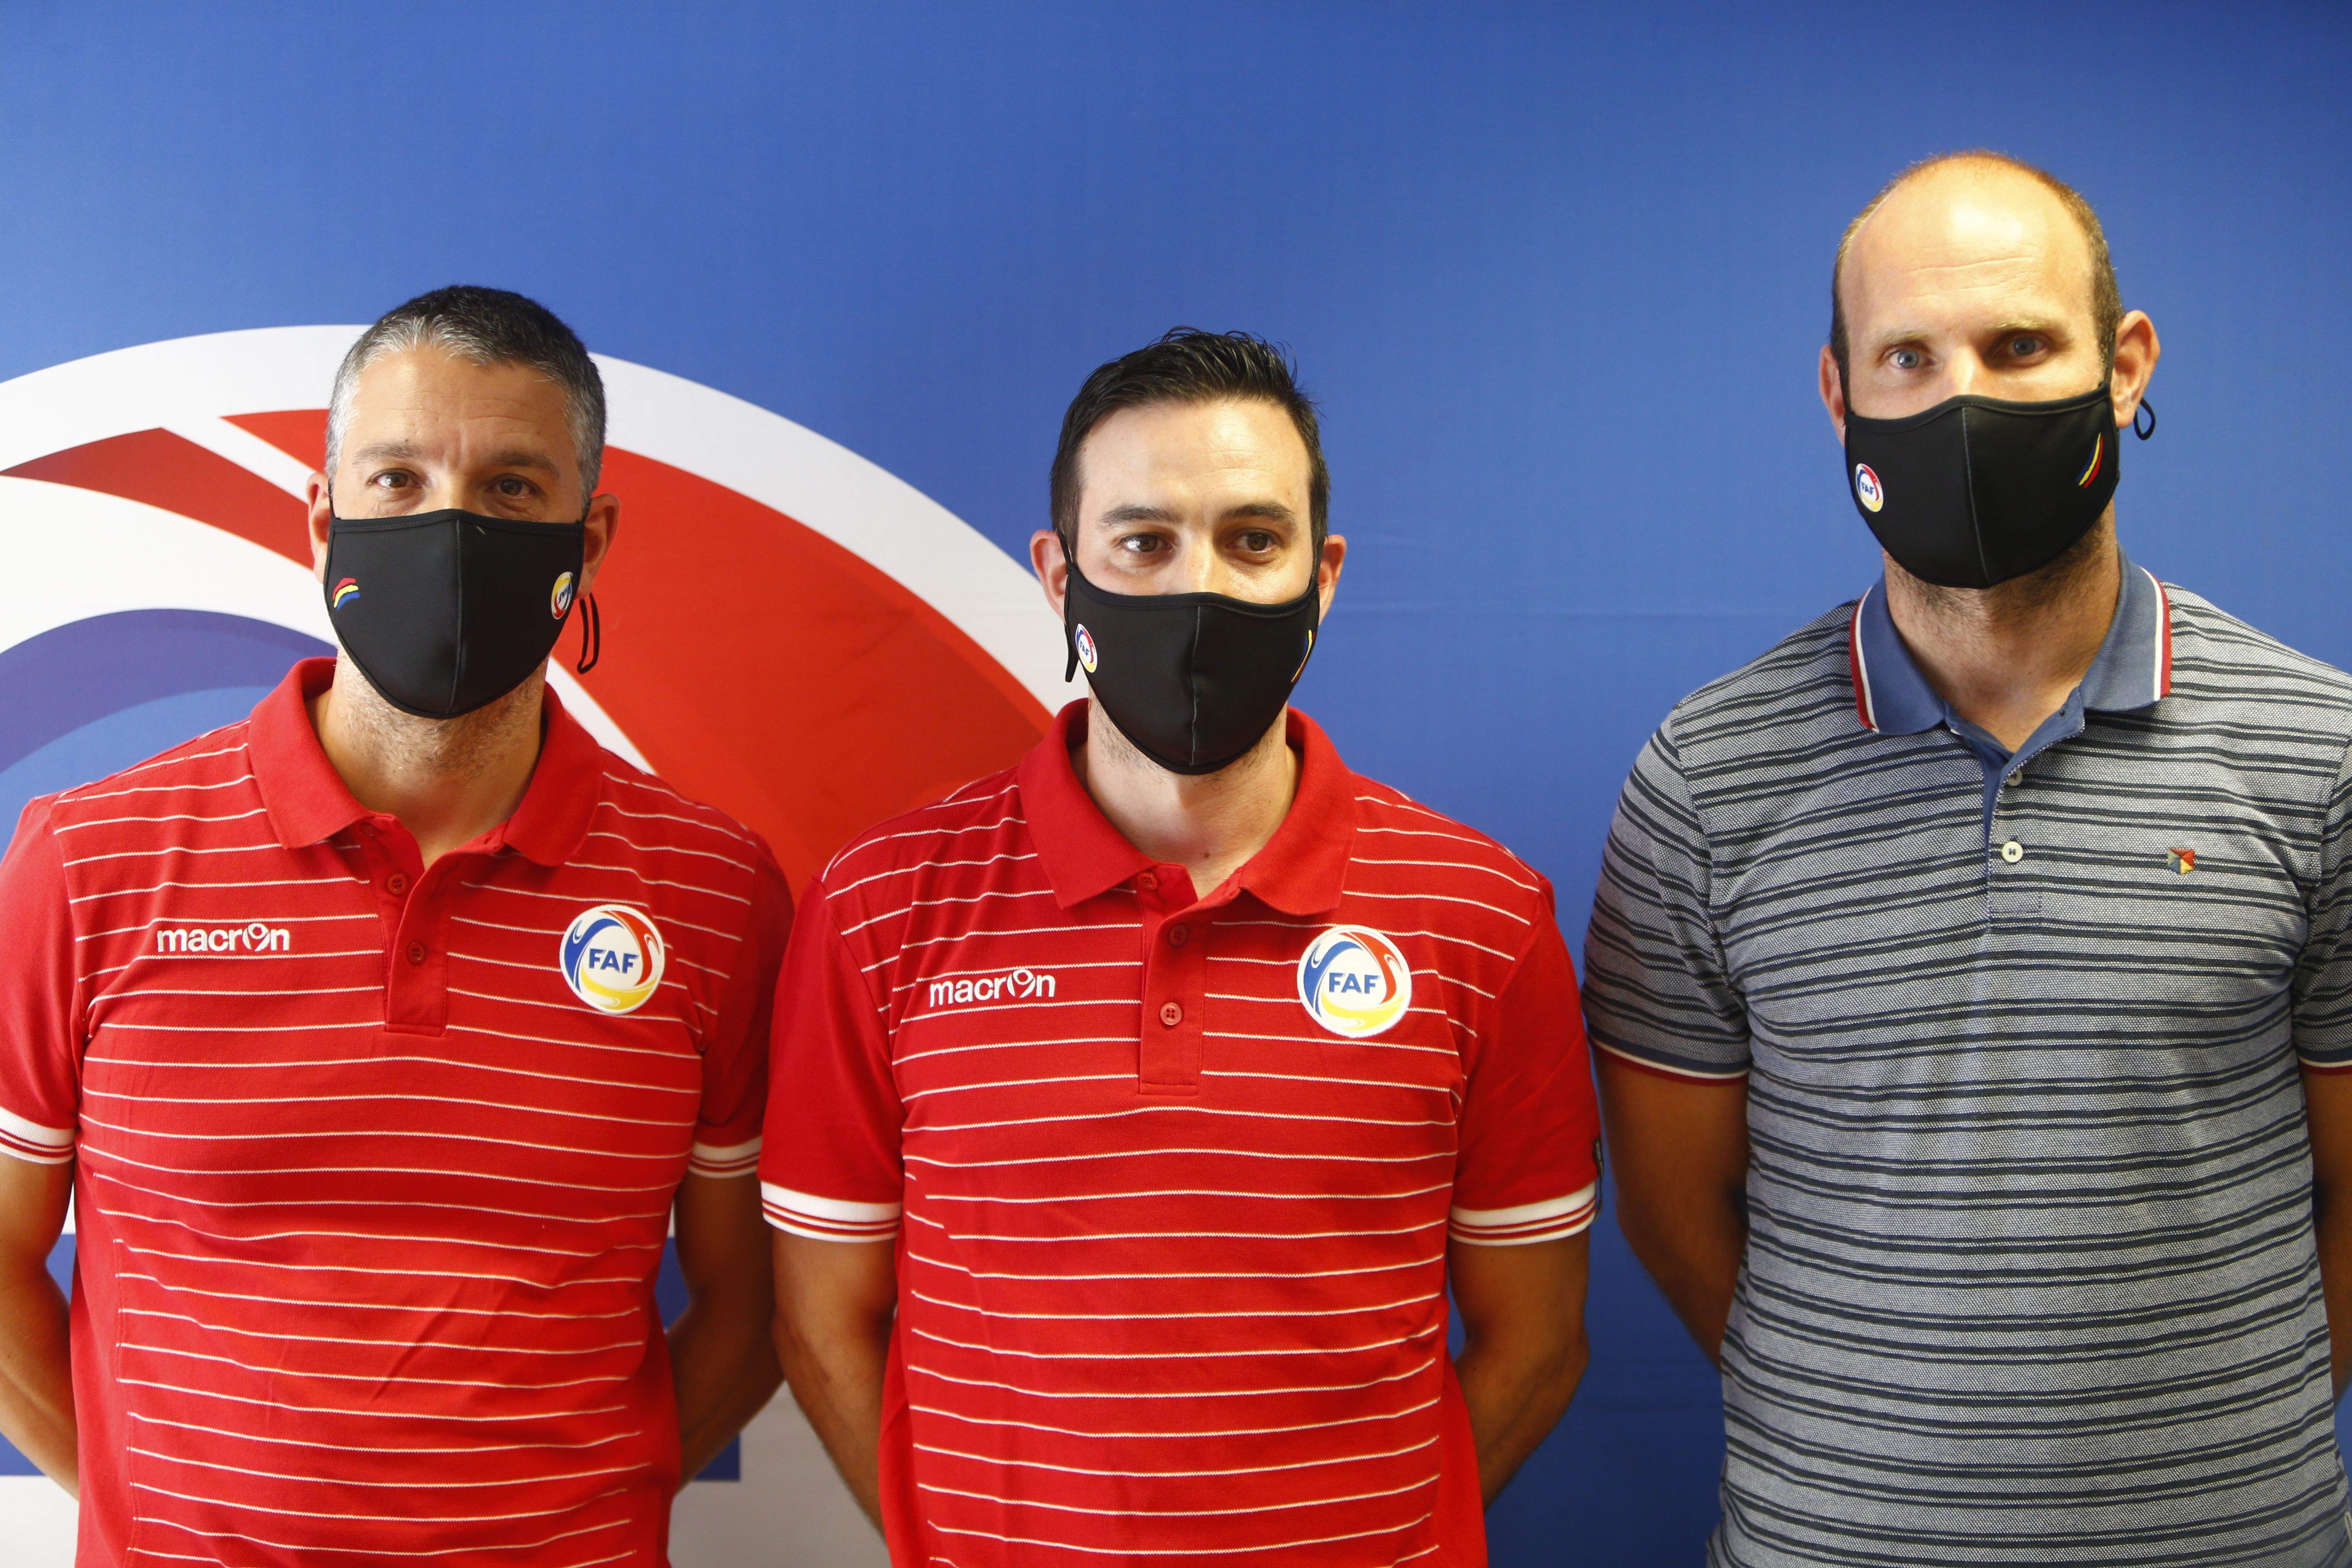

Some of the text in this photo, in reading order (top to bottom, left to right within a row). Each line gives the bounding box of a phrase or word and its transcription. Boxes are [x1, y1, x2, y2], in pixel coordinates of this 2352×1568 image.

[1862, 482, 1874, 495] FAF
[1080, 639, 1089, 656] FAF
[157, 923, 290, 952] macron
[588, 948, 639, 975] FAF
[930, 969, 1056, 1008] macron
[1328, 972, 1381, 994] FAF
